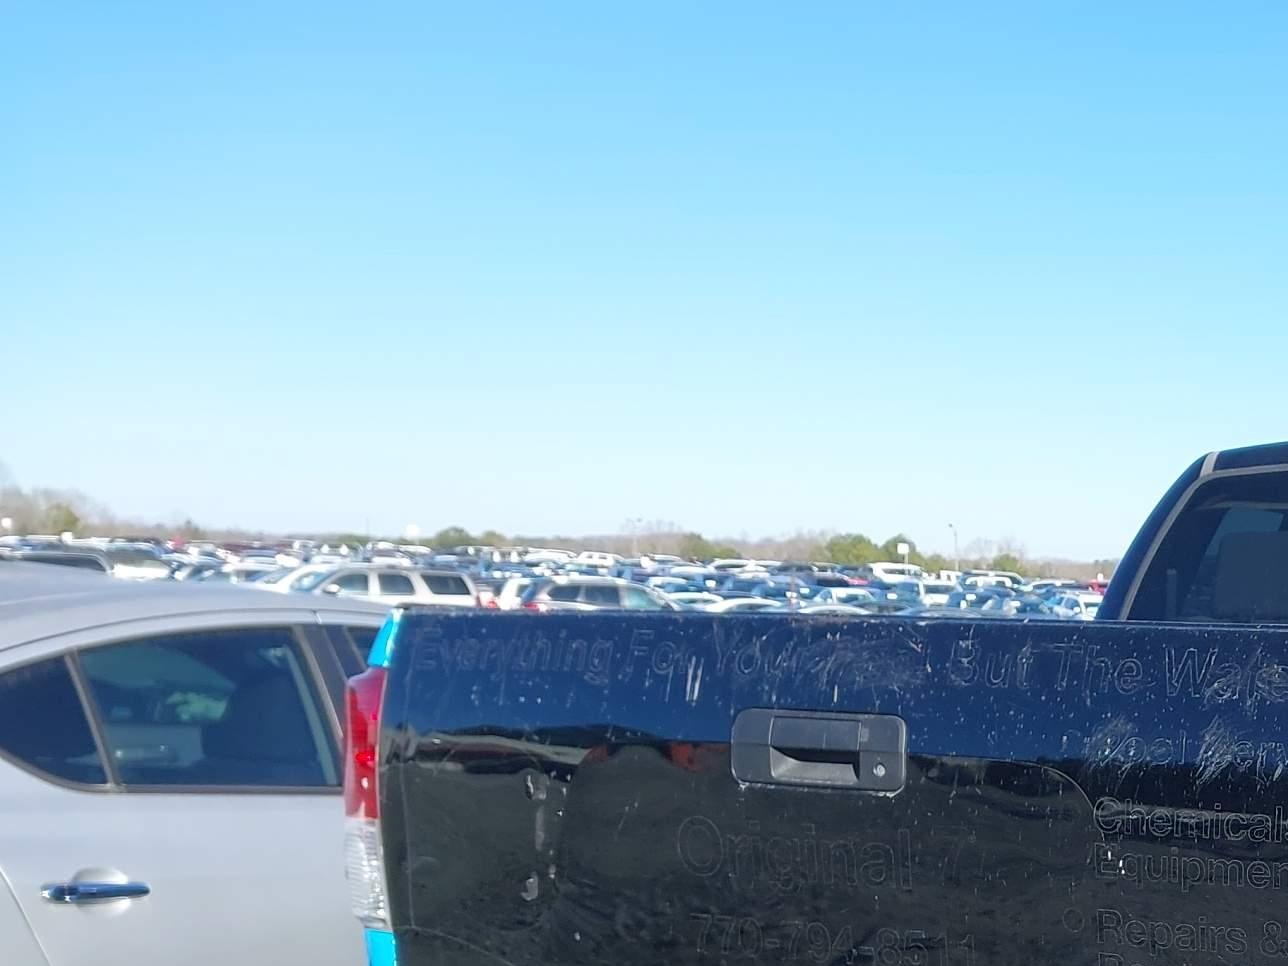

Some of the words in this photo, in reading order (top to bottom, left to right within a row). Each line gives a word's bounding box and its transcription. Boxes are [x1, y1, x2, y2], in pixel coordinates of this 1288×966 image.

[948, 640, 1034, 689] But
[1046, 644, 1146, 695] The
[1097, 731, 1188, 768] ool
[676, 815, 914, 893] Original
[1096, 909, 1248, 957] Repairs
